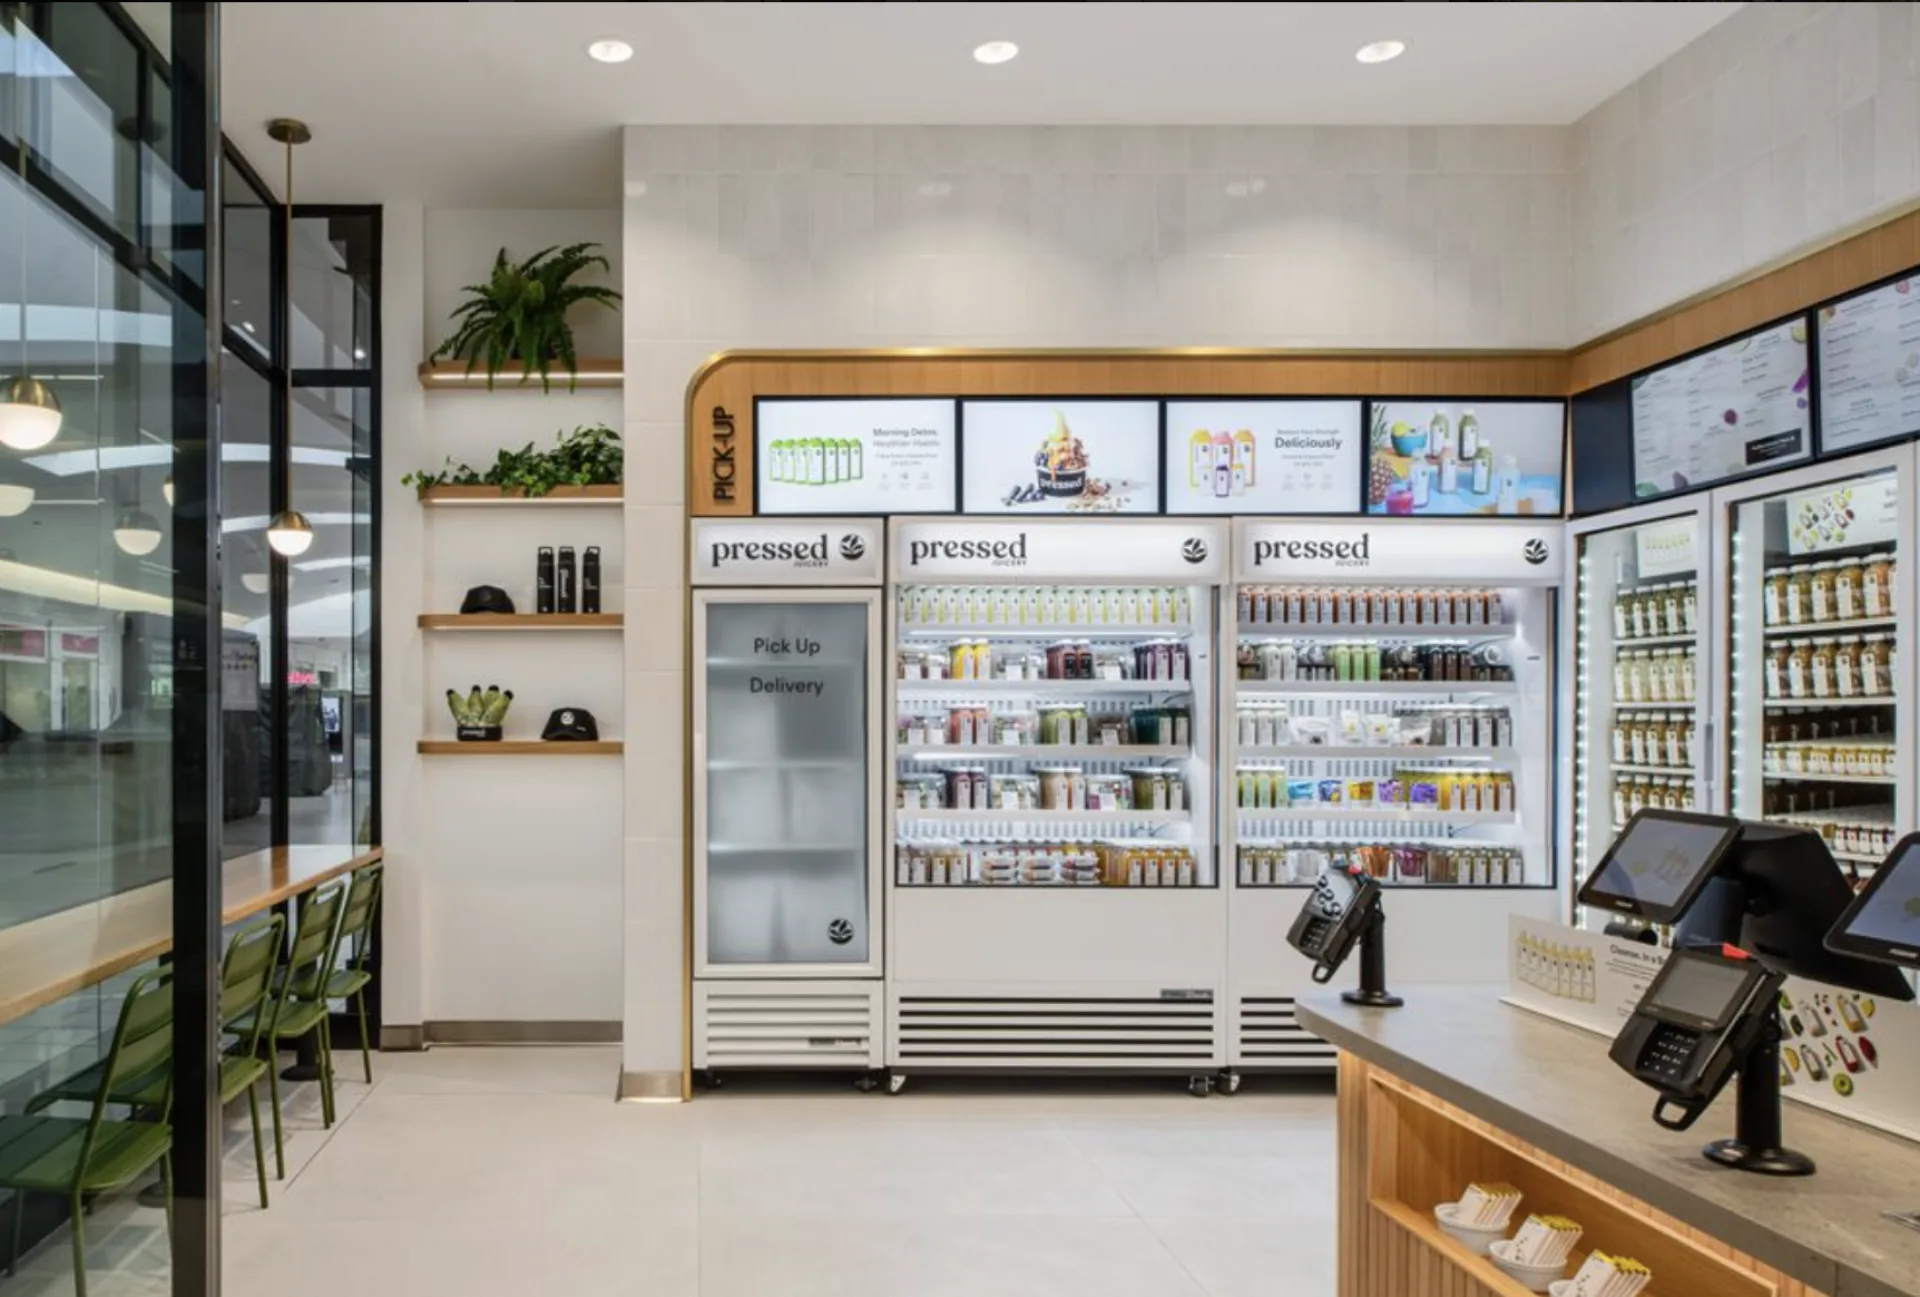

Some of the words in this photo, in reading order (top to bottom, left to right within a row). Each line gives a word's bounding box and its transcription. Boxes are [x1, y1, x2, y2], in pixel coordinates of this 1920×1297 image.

[713, 406, 735, 501] PICK-UP
[1275, 437, 1343, 449] Deliciously
[712, 533, 828, 567] pressed
[911, 533, 1026, 565] pressed
[1254, 533, 1369, 565] pressed
[754, 638, 790, 653] Pick
[796, 638, 821, 656] Up
[750, 677, 824, 698] Delivery
